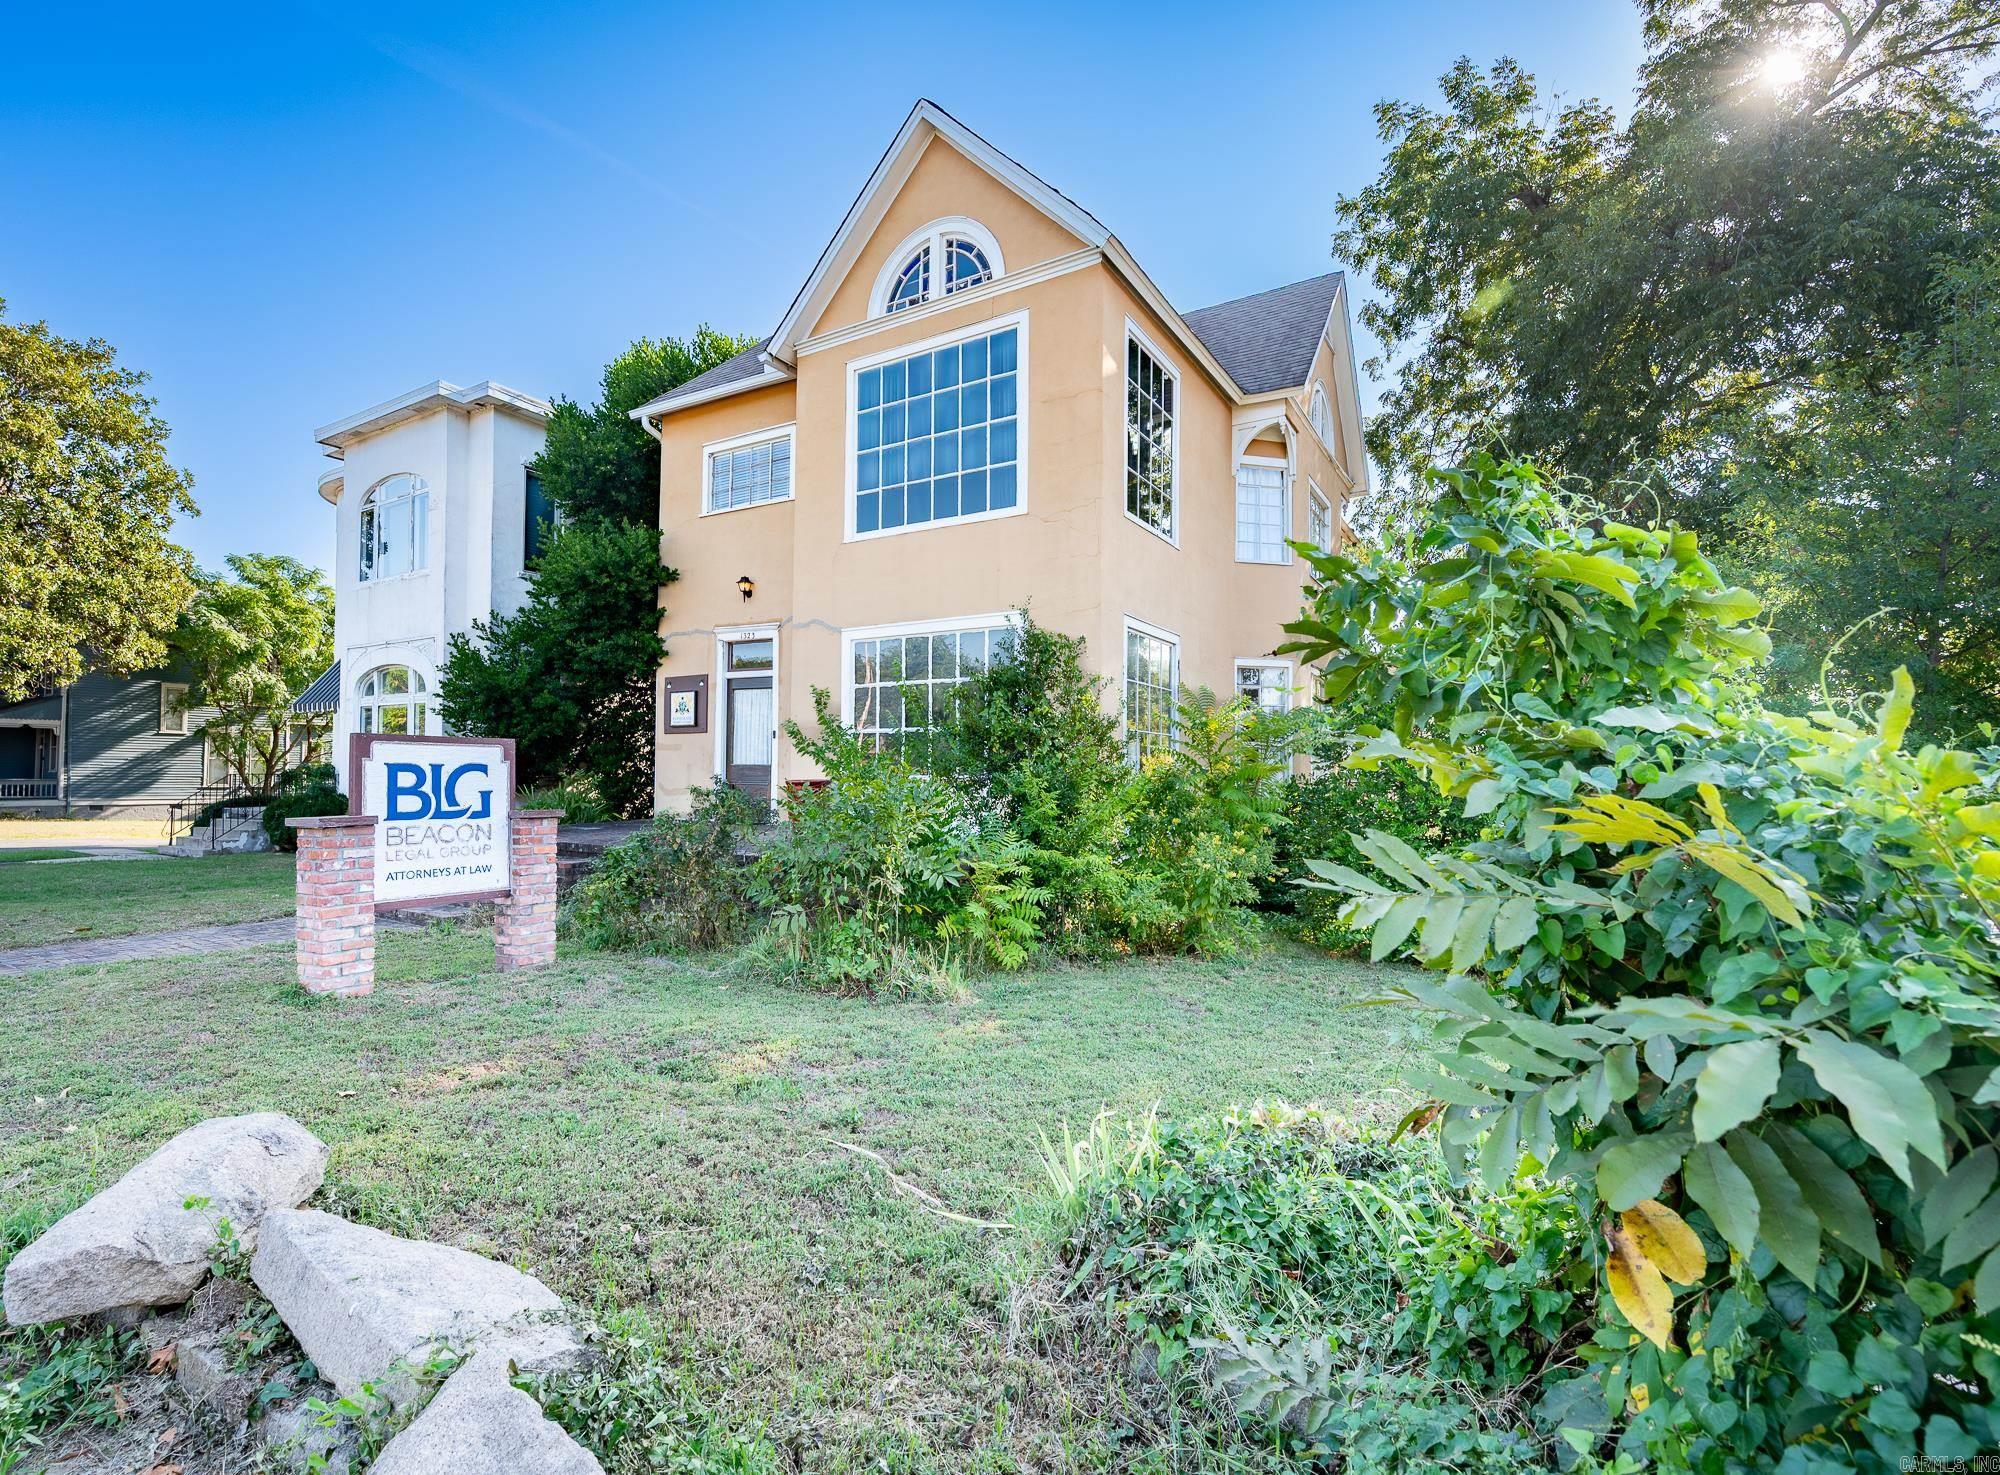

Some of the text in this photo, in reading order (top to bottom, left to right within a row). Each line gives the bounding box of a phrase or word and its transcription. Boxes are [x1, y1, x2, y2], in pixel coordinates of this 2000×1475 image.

[383, 762, 493, 821] BLG
[386, 823, 492, 846] BEACON
[385, 844, 492, 862] LEGAL GROUP
[385, 864, 493, 882] ATTORNEYS AT LAW
